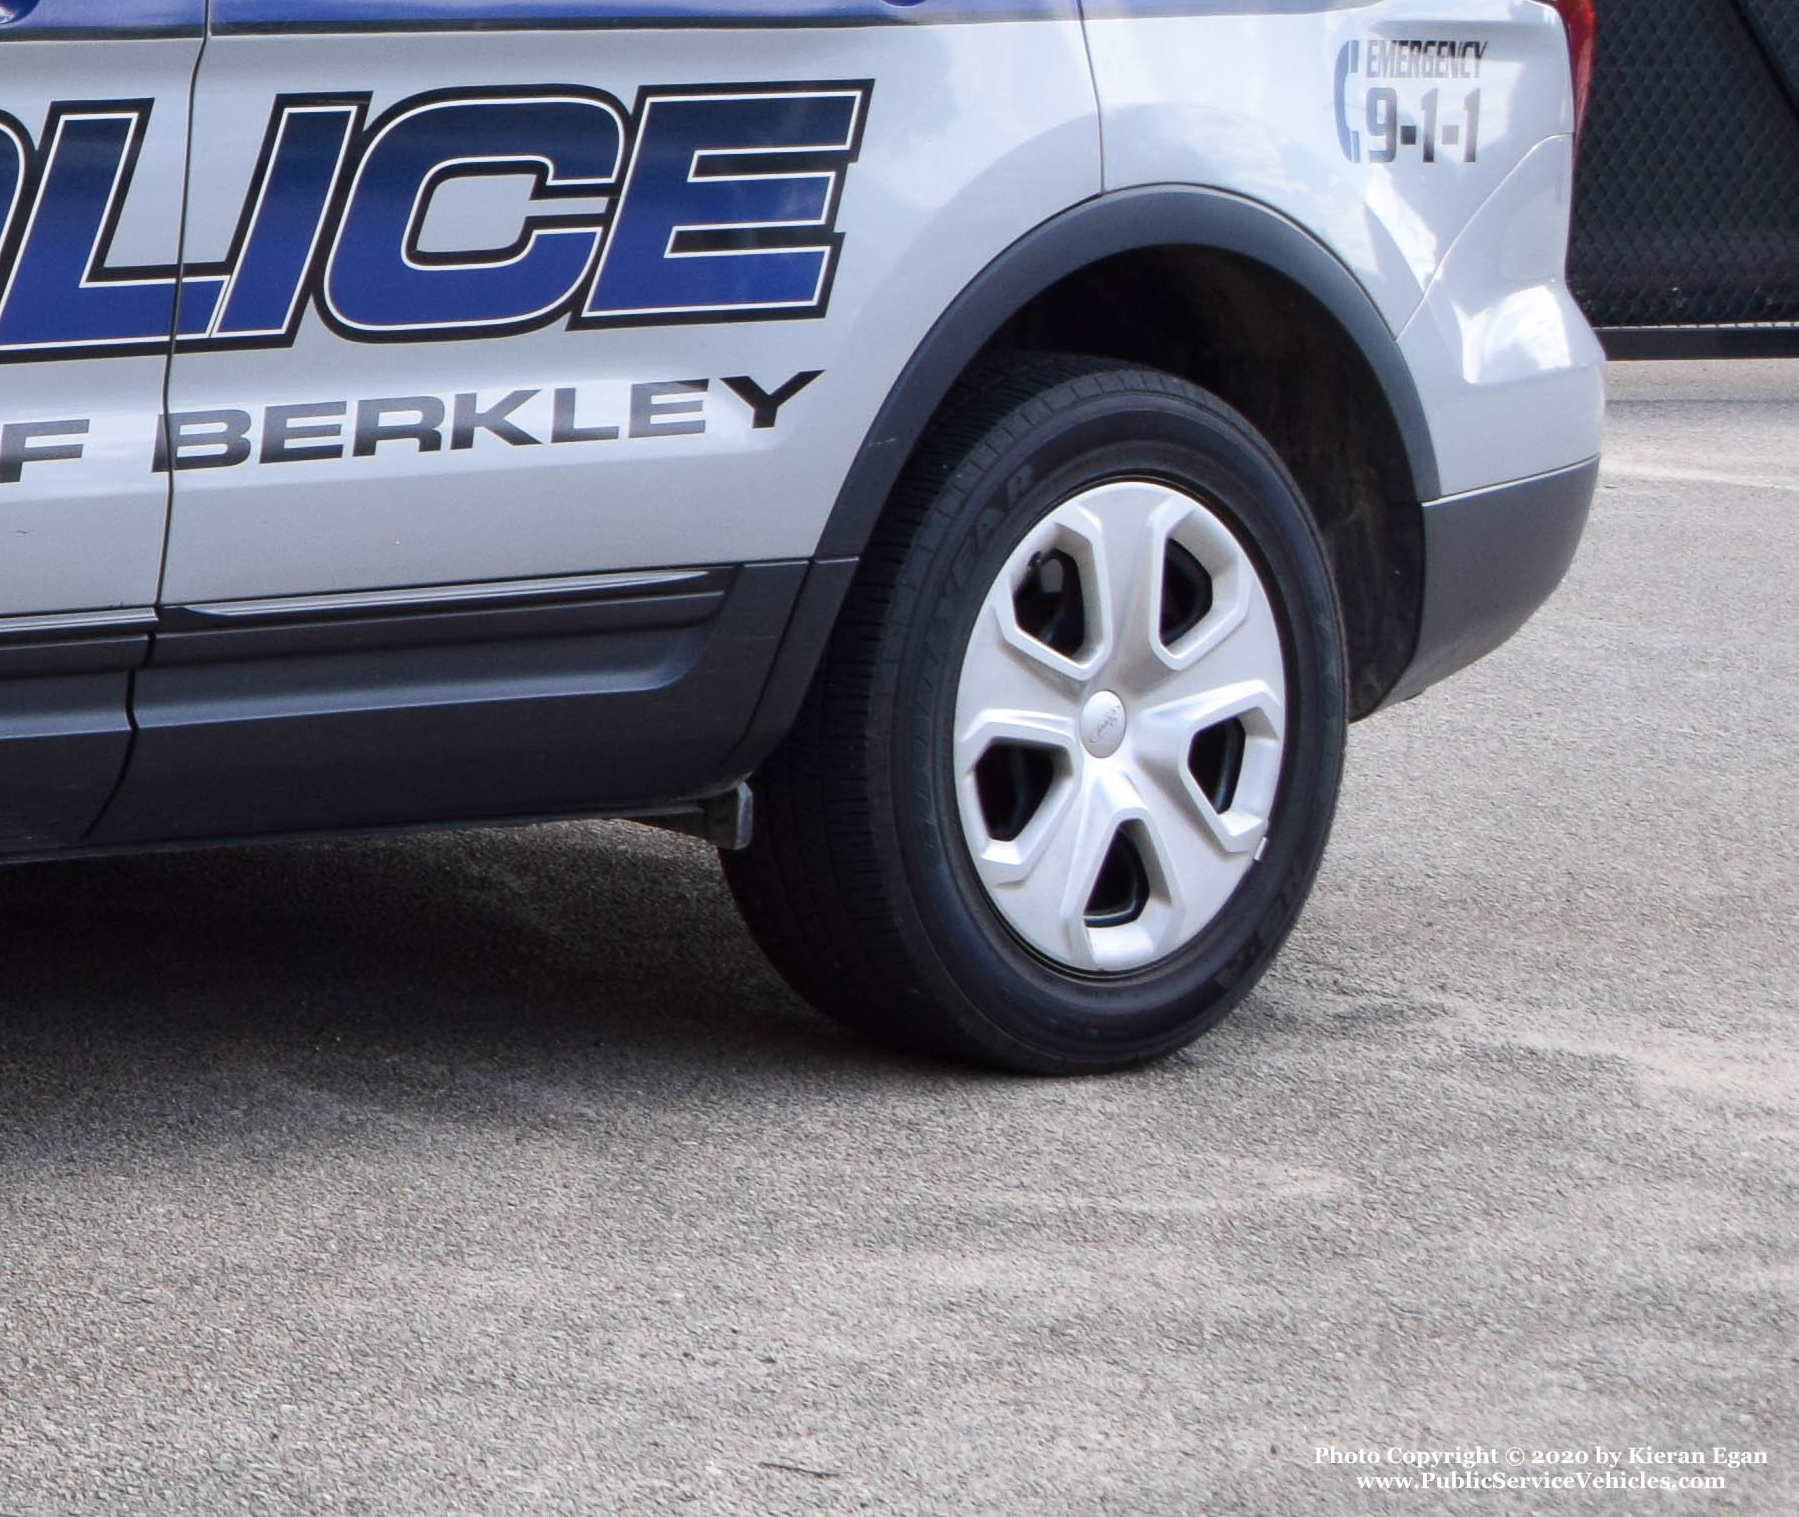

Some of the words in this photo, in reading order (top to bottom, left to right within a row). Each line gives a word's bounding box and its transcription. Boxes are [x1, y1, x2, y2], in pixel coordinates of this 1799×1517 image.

[1366, 39, 1489, 79] EMERGENCY
[1365, 87, 1482, 163] 9-1-1
[151, 369, 825, 473] BERKLEY
